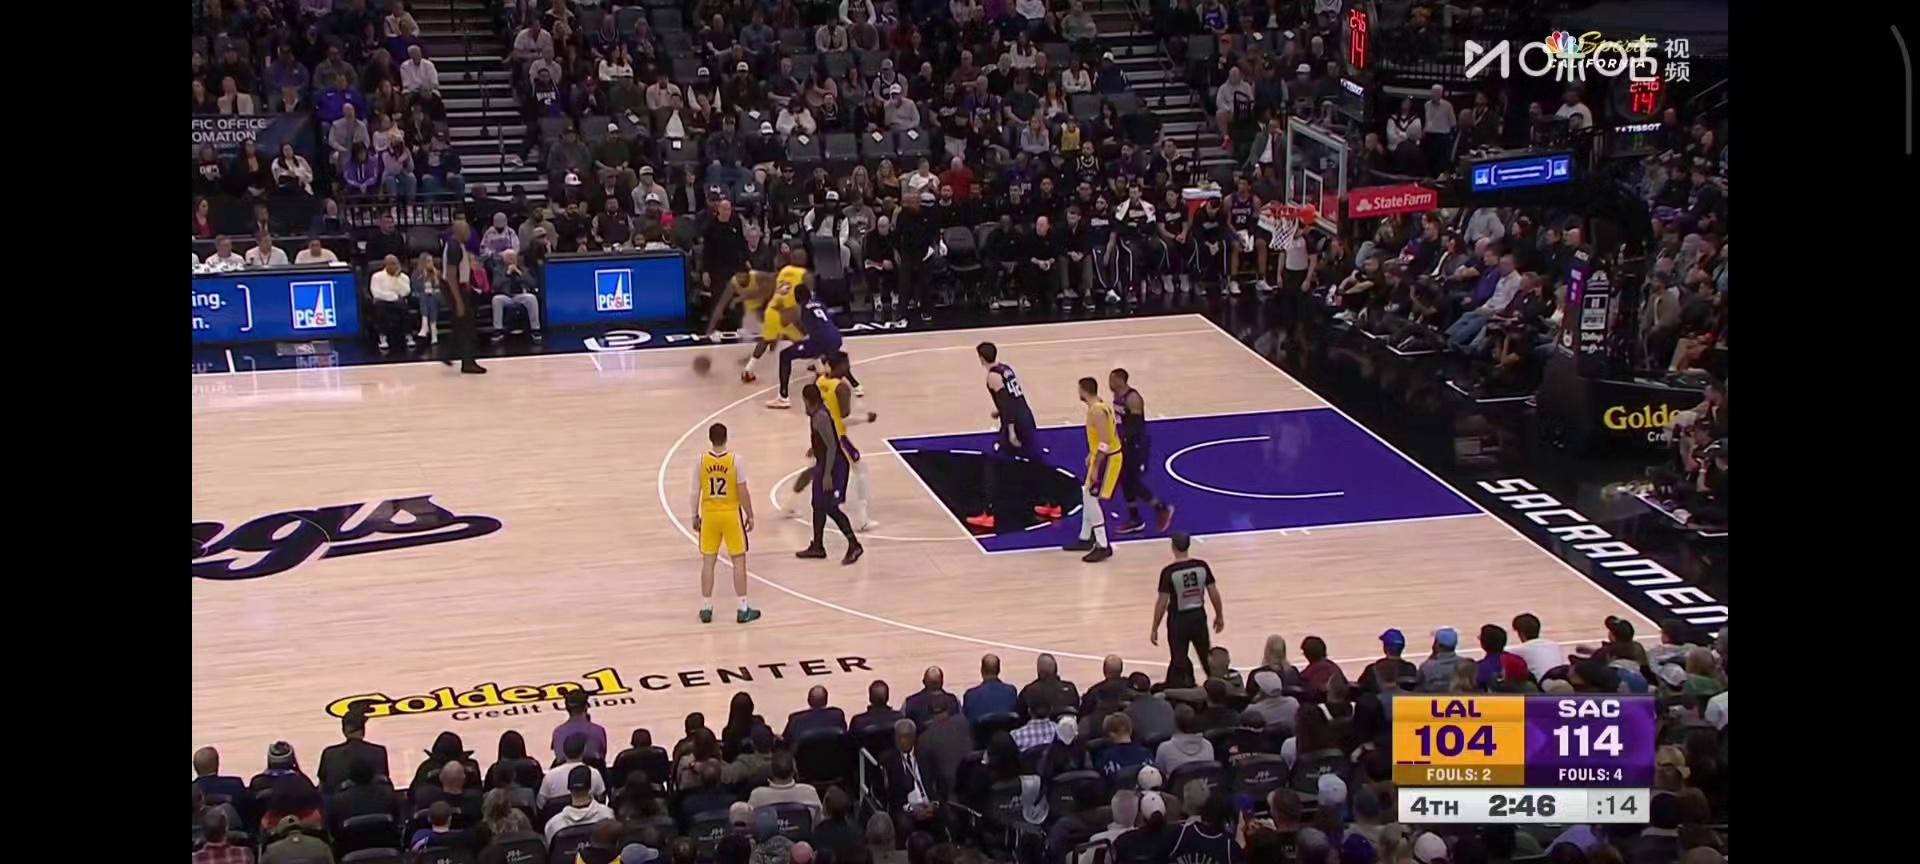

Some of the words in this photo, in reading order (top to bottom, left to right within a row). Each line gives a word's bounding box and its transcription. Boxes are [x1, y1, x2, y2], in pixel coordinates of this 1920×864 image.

[1632, 92, 1654, 114] 14
[217, 118, 267, 130] OFFICE
[192, 130, 256, 142] OMATION
[598, 292, 631, 309] PG&E
[295, 308, 334, 327] PG&E
[813, 308, 828, 322] 9
[709, 477, 727, 496] 12
[192, 495, 502, 580] gs
[1183, 571, 1198, 588] 29
[639, 656, 873, 692] CENTER
[452, 703, 542, 721] Credit
[553, 696, 636, 712] Uion
